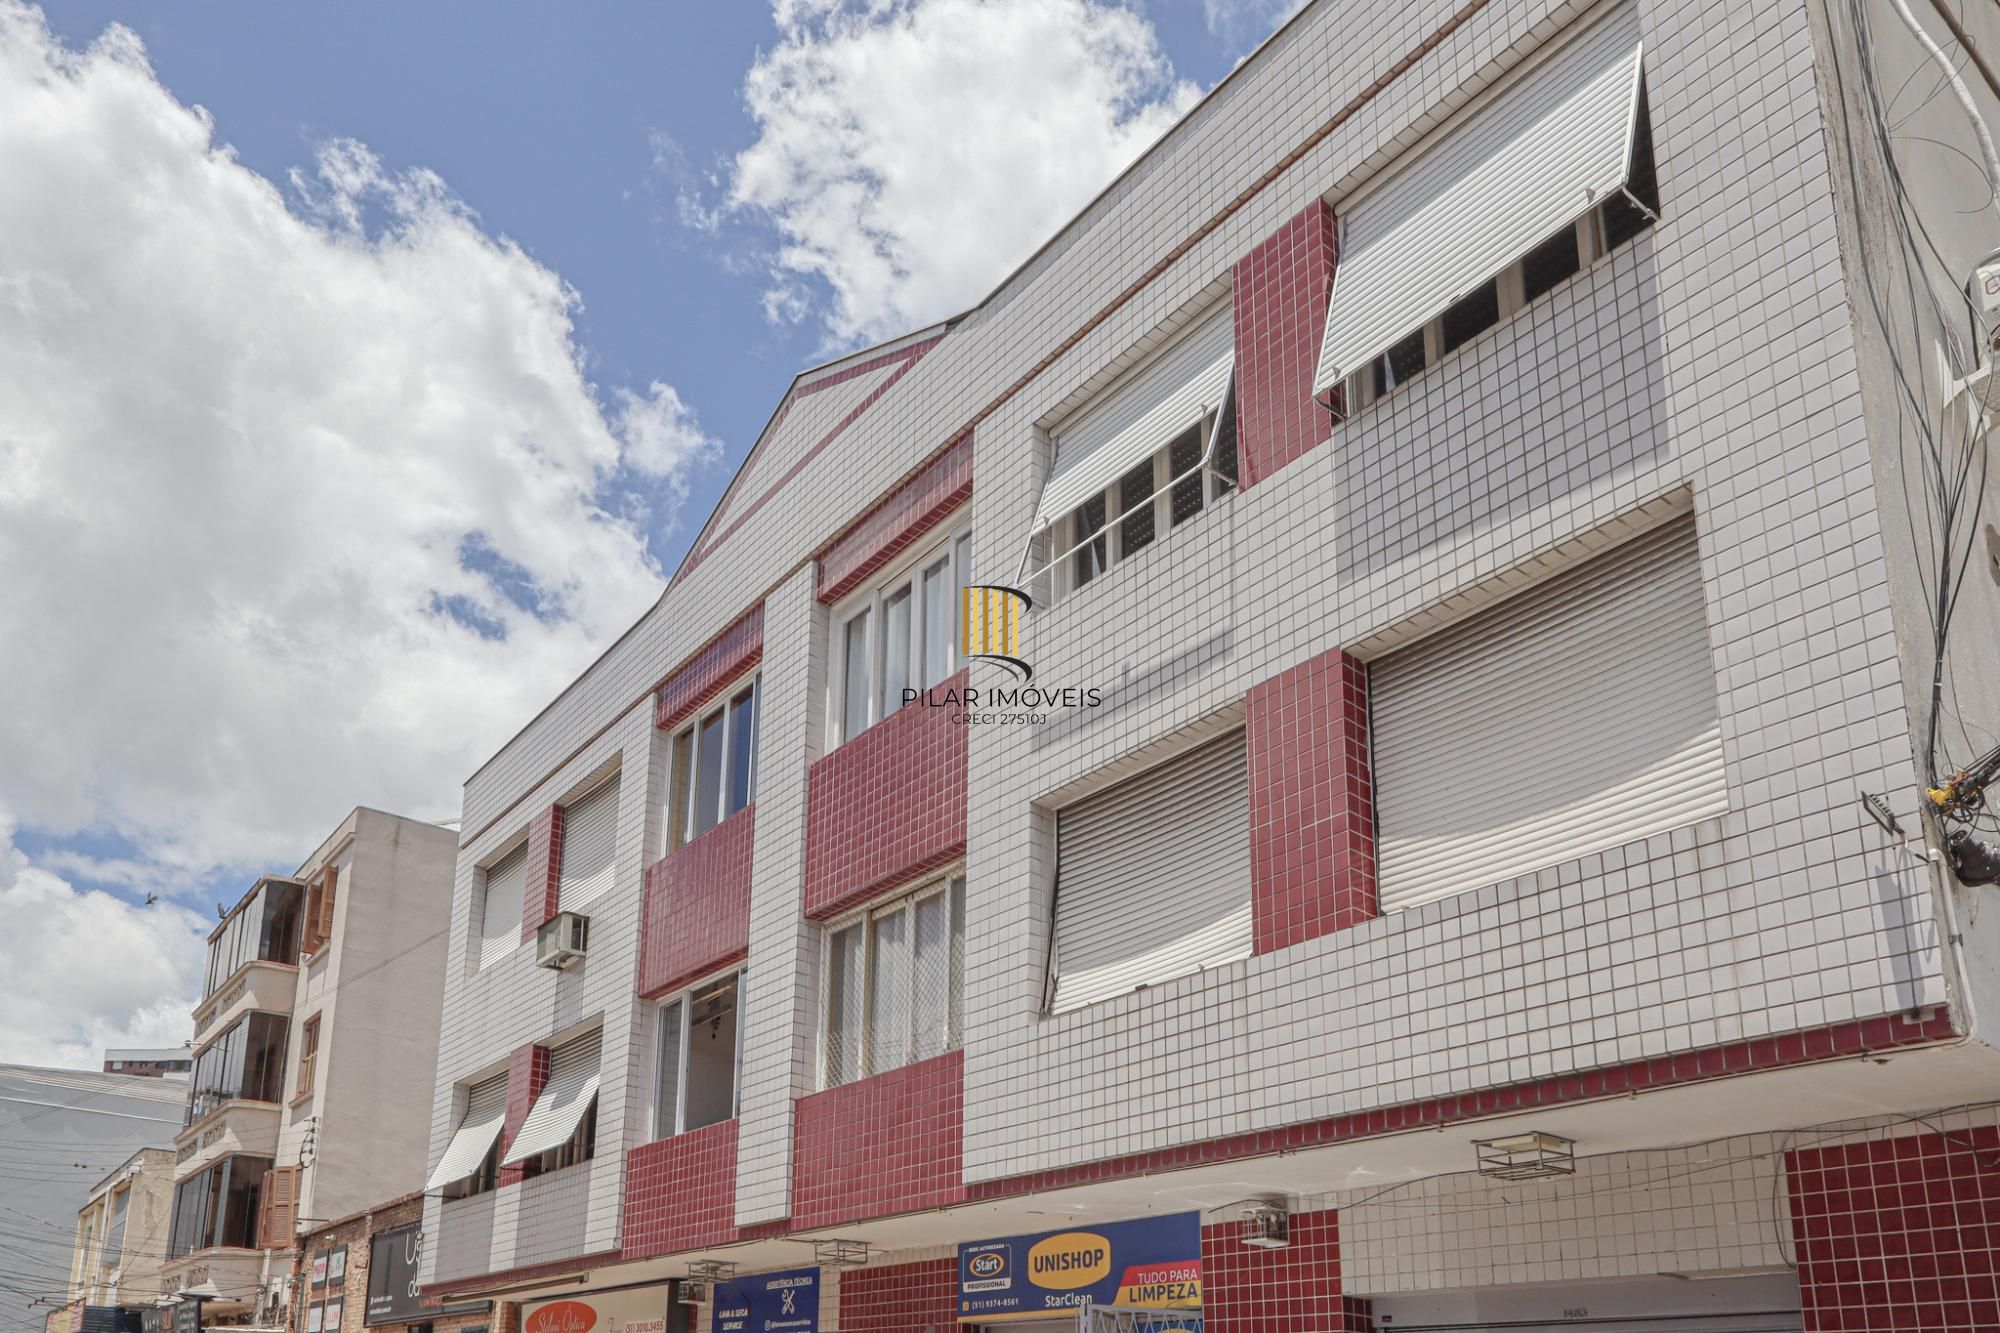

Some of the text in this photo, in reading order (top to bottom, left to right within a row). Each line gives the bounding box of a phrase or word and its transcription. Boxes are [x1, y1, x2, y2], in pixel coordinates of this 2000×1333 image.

[975, 1258, 998, 1272] Start
[1033, 1248, 1105, 1274] UNISHOP
[1137, 1268, 1198, 1285] TUDO PARA
[967, 1281, 1006, 1291] PROFISSIONAL
[1129, 1282, 1198, 1303] LIMPEZA
[1045, 1292, 1093, 1308] StarClean
